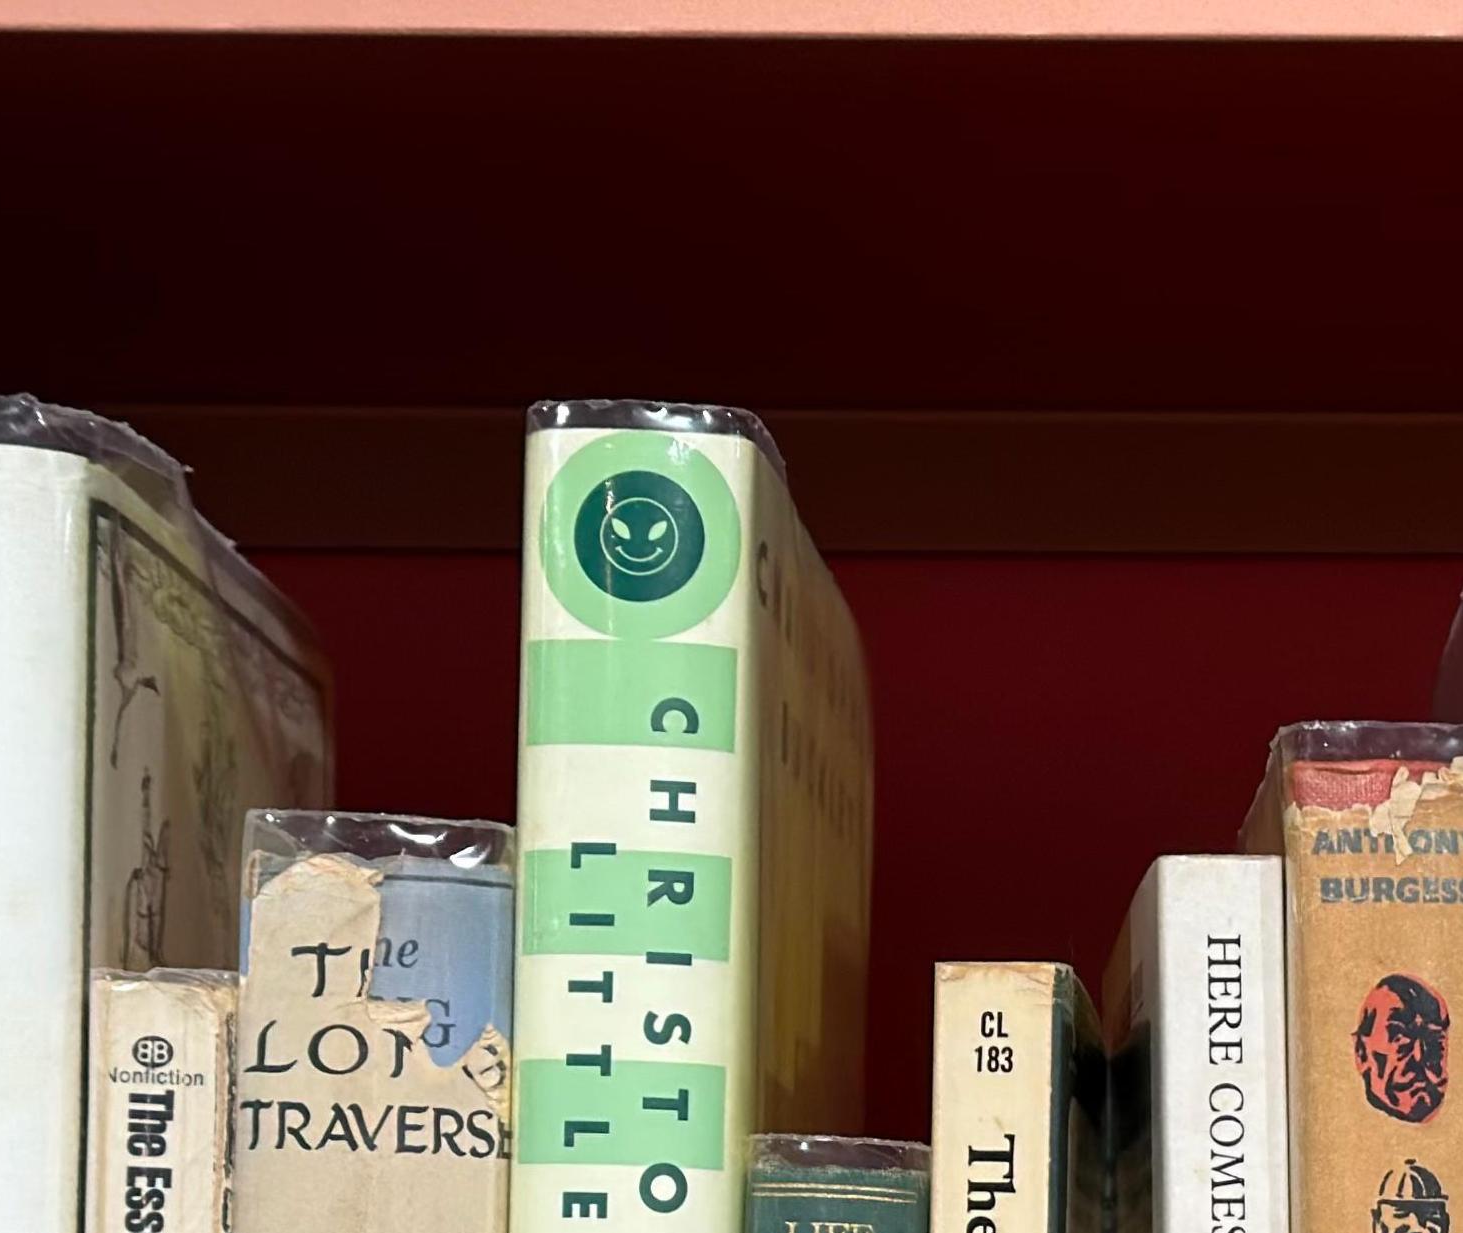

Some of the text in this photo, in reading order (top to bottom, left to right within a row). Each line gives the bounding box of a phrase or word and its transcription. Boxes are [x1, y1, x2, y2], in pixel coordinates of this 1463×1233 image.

[561, 842, 617, 1219] LITTLE
[980, 1011, 1009, 1038] CL
[1206, 933, 1244, 1065] HERE
[974, 1046, 1014, 1073] 183
[126, 1089, 176, 1157] The
